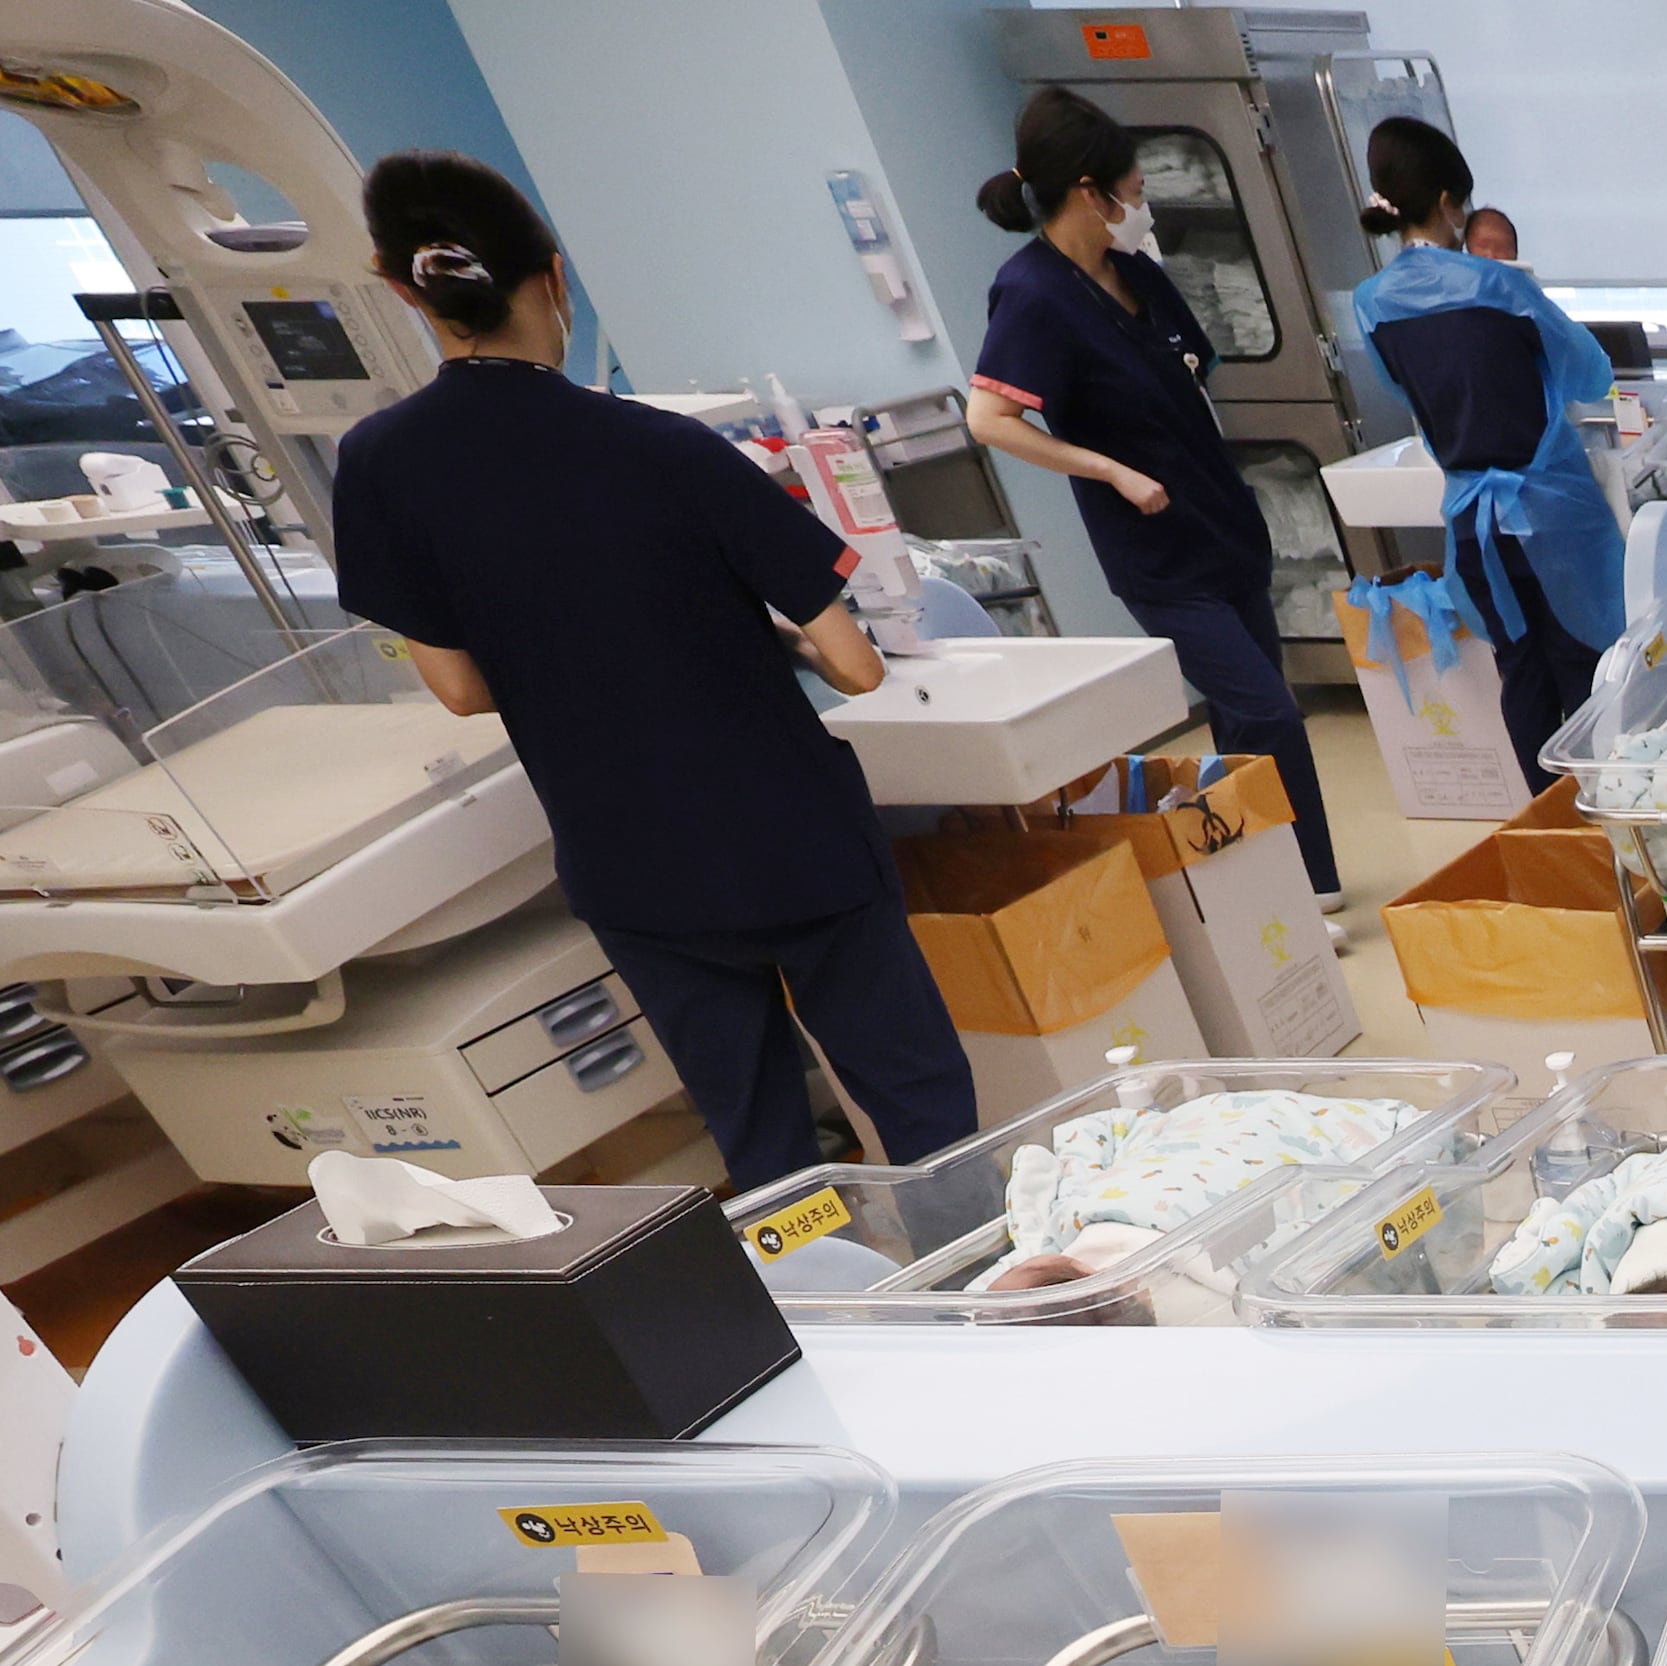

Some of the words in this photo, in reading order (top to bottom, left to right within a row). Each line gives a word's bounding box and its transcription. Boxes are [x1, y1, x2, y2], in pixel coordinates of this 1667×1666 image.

[781, 1200, 840, 1239] 낙상주의
[1397, 1196, 1436, 1235] 낙상주의
[554, 1512, 652, 1540] 낙상주의
